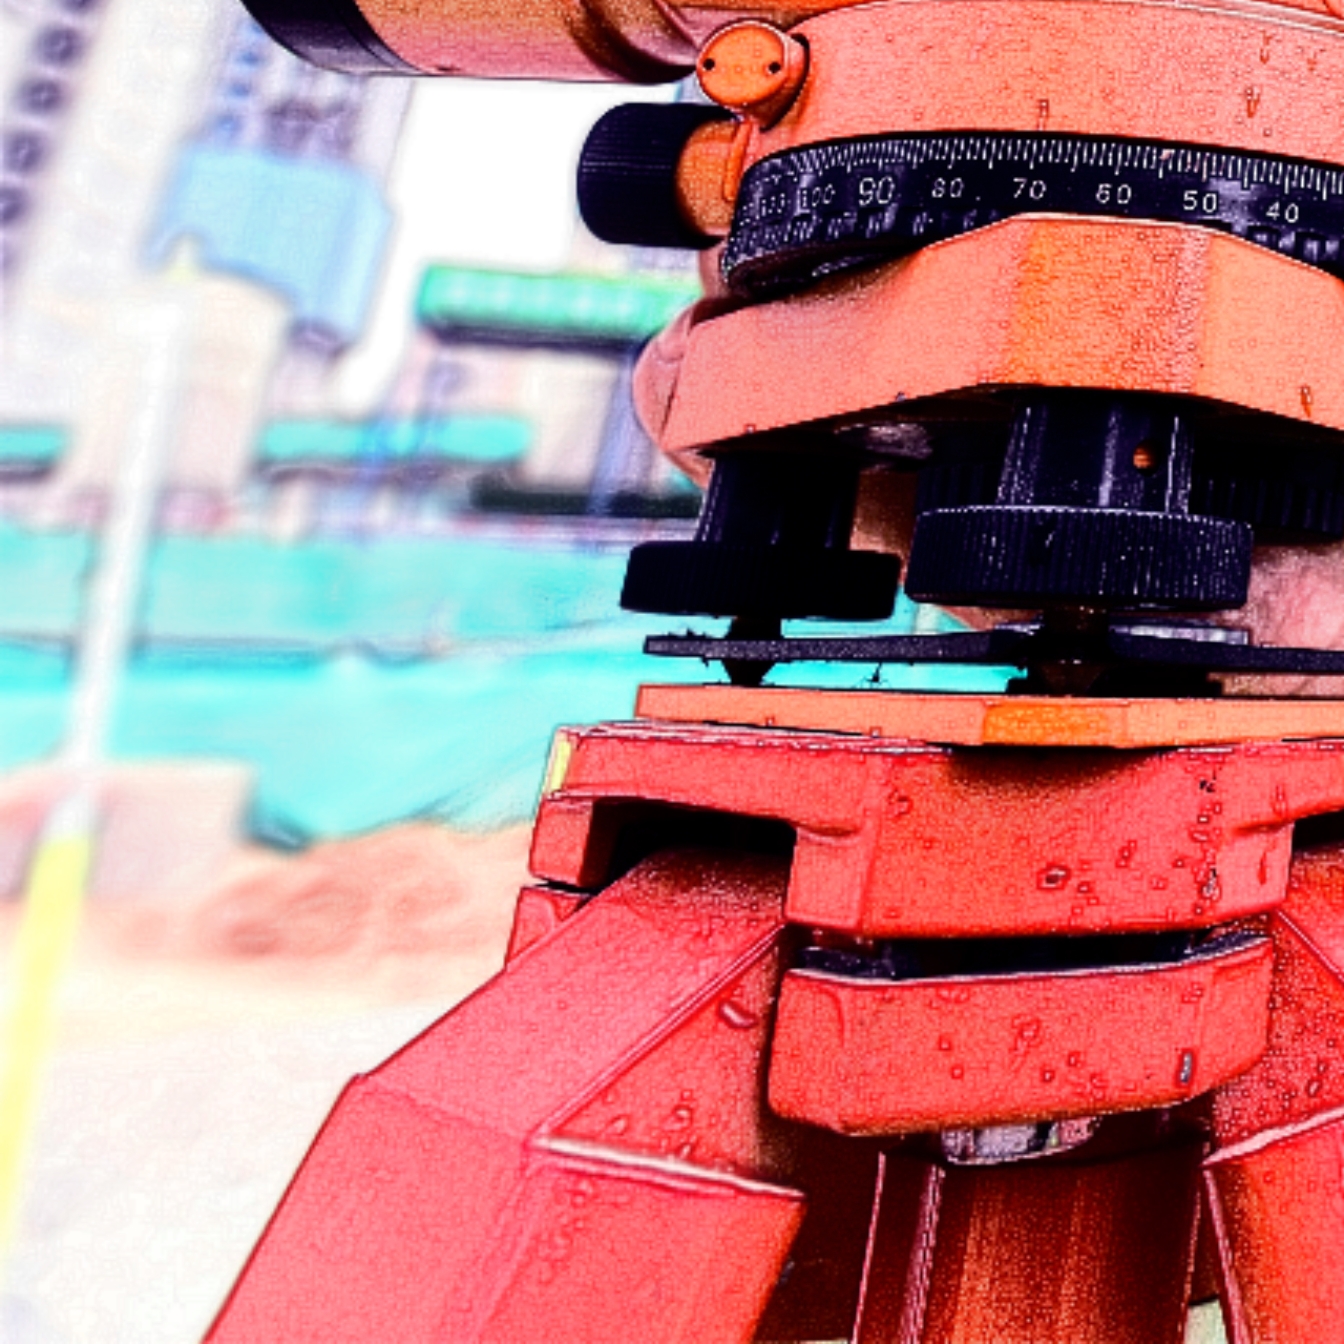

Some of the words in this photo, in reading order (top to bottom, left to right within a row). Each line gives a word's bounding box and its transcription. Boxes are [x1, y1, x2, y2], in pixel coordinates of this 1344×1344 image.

[859, 176, 896, 207] 90
[1012, 177, 1047, 201] 70
[1096, 183, 1132, 205] 60
[1182, 189, 1218, 213] 50
[1265, 201, 1299, 223] 40
